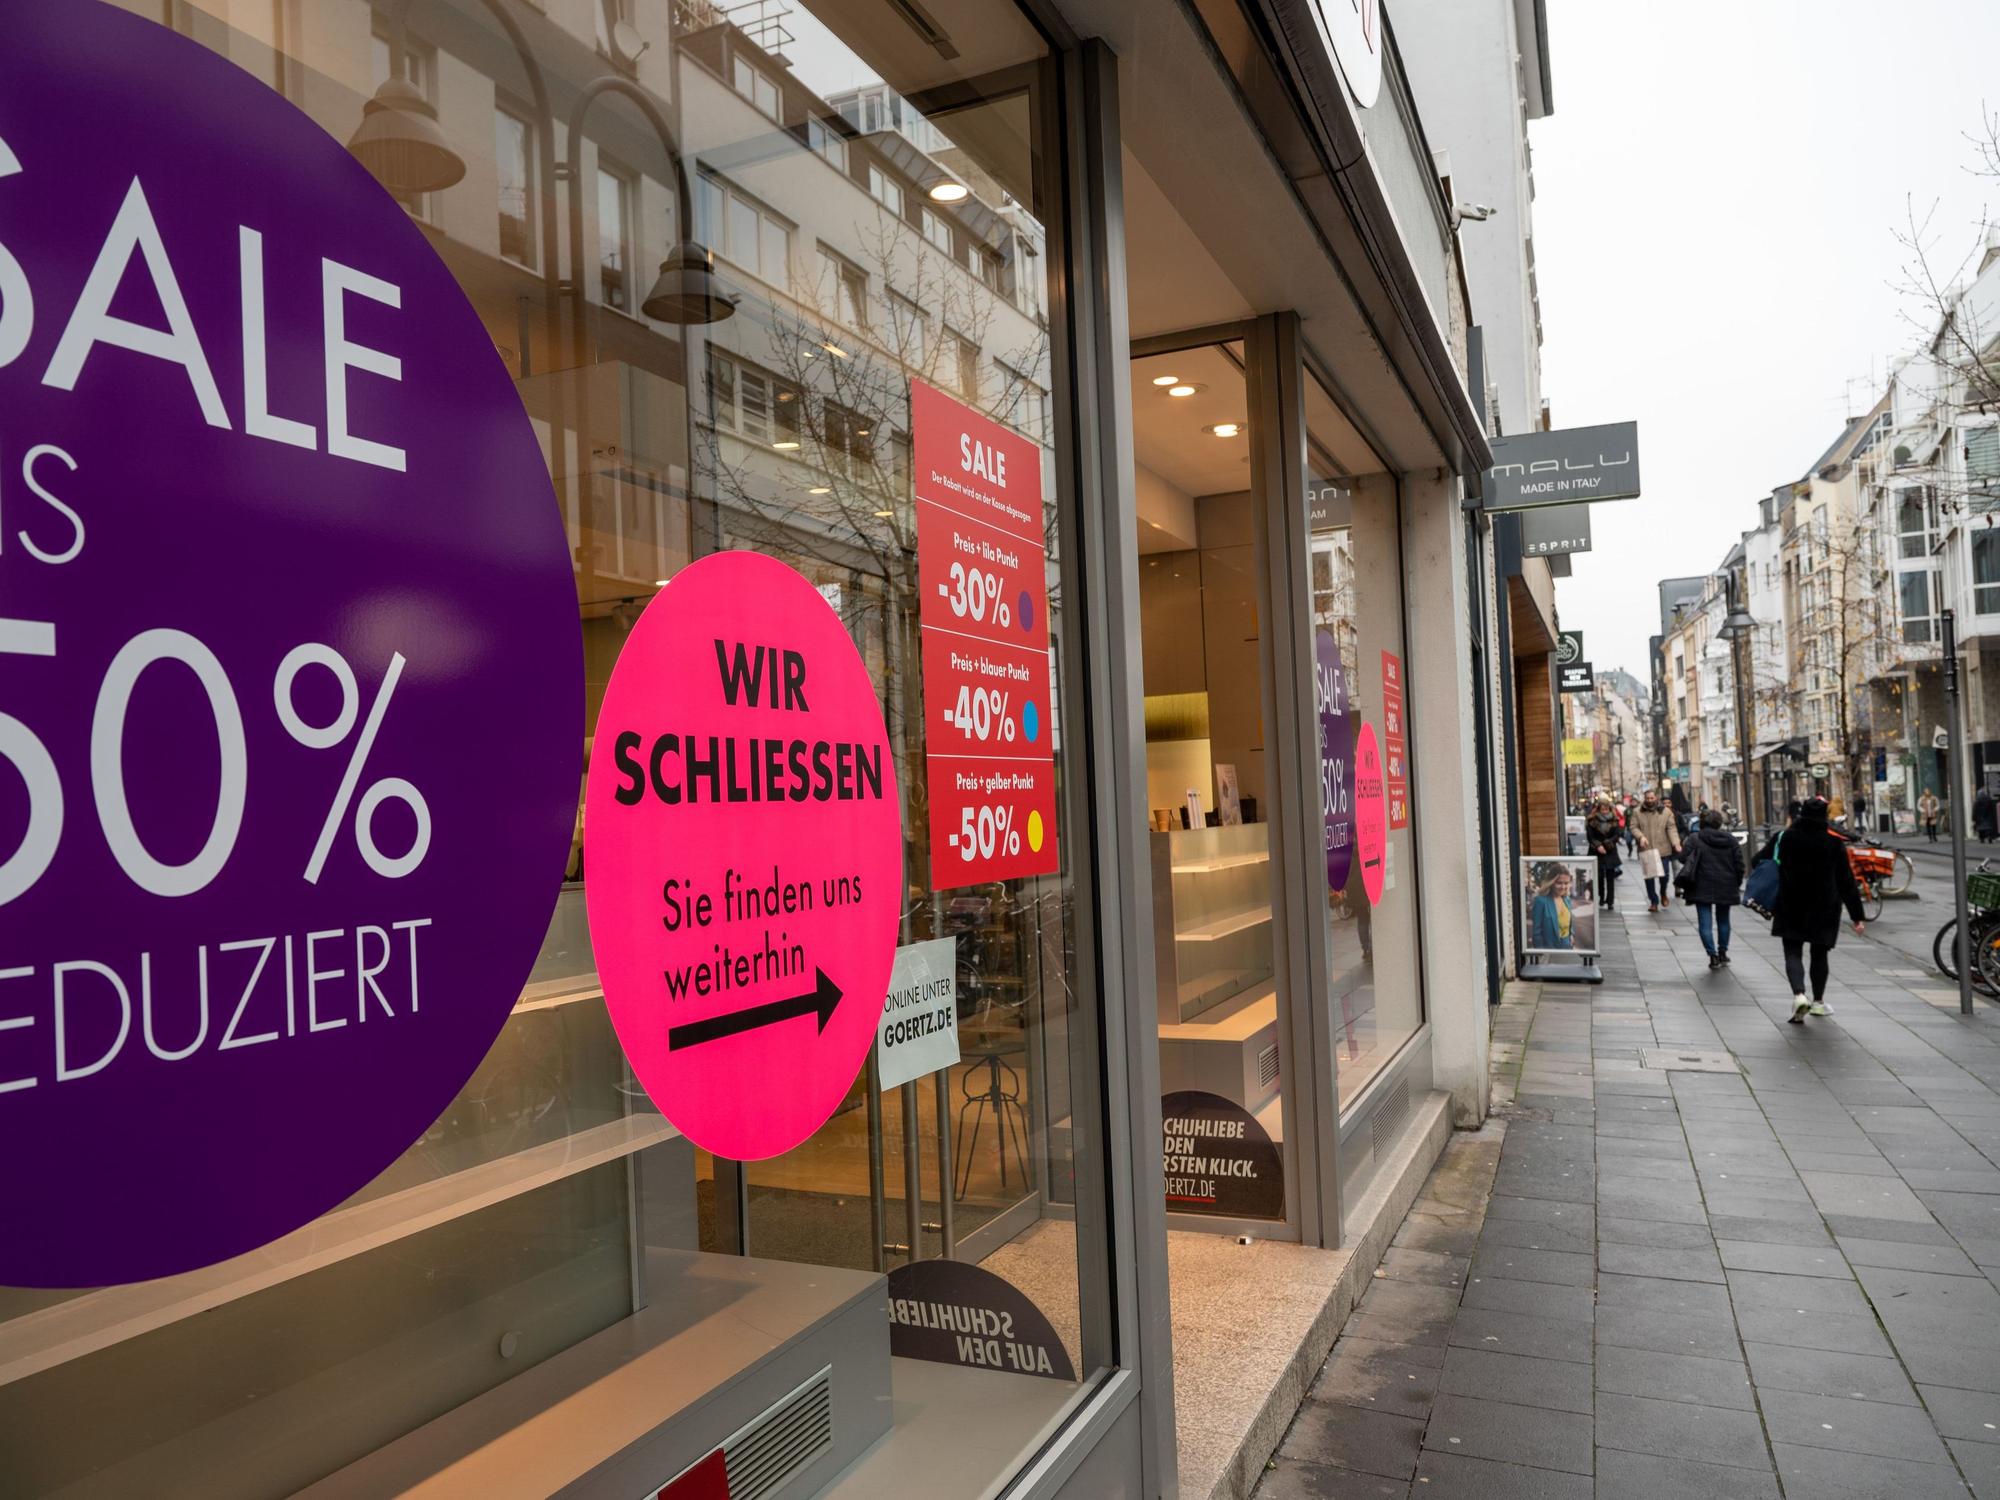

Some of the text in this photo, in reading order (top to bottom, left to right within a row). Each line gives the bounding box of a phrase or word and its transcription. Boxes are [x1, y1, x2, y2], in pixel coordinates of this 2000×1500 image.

[960, 432, 1006, 488] SALE
[932, 471, 1031, 523] Der Rabatt wird an der Kasse abgezogen
[1521, 477, 1601, 495] MADE IN ITALY
[954, 532, 1018, 569] Preis + lila Punkt
[1528, 538, 1586, 553] ESPRIT
[938, 562, 1010, 628] -30%
[714, 639, 810, 712] WIR
[951, 652, 1029, 681] Preis + blauer Punkt
[944, 685, 1015, 742] -40%
[614, 731, 882, 806] SCHLIESSEN
[956, 772, 1034, 795] Preis + gelber Punkt
[949, 805, 1020, 862] -50%
[663, 865, 862, 932] Sie finden uns
[664, 930, 805, 1003] weiterhin
[884, 978, 951, 1013] ONLINE UNTER
[884, 1006, 952, 1048] GOERTZ.DE
[1164, 1136, 1195, 1155] DEN
[1209, 1157, 1257, 1178] KLICK.
